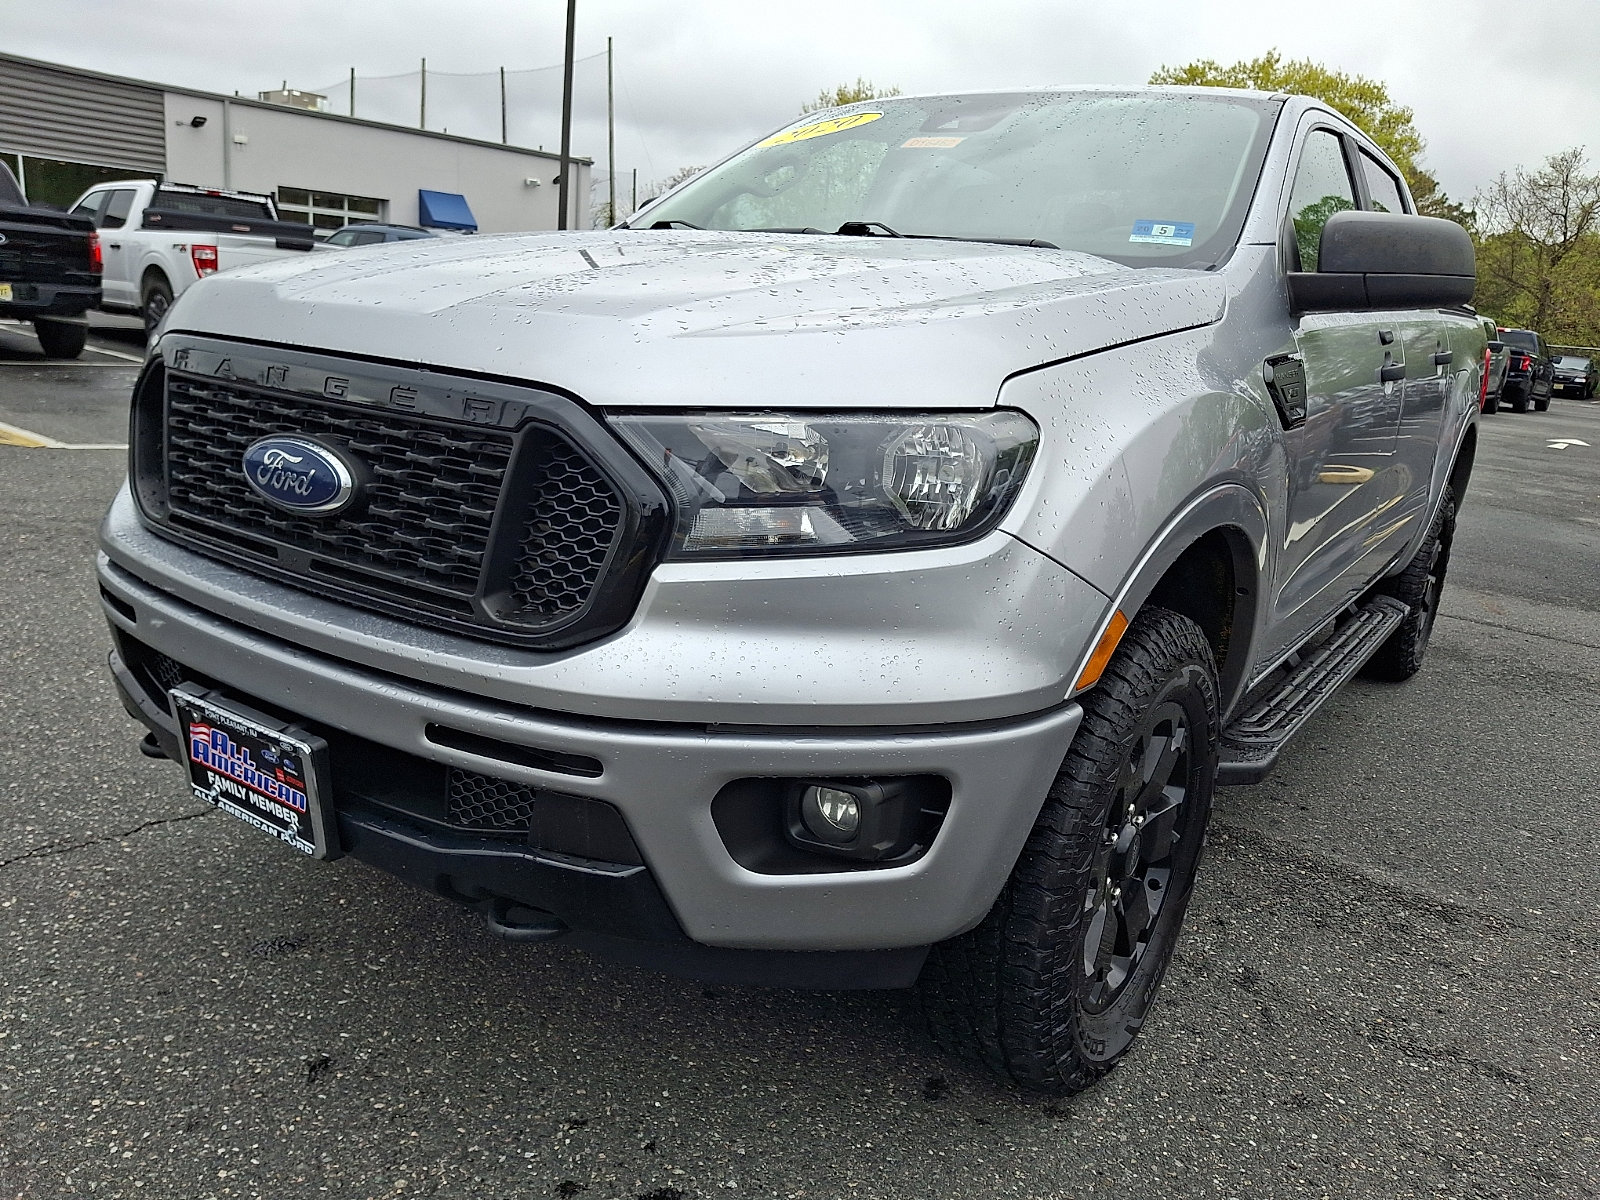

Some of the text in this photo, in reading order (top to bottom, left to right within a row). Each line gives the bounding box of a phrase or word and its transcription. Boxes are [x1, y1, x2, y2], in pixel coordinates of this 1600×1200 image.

[1159, 226, 1168, 235] 5
[174, 349, 495, 422] RANGER
[256, 448, 313, 498] Ford
[190, 738, 307, 813] AMERICAN
[207, 771, 246, 800] FAMILY
[249, 790, 299, 828] MEMBER
[217, 801, 278, 837] AMERICAN
